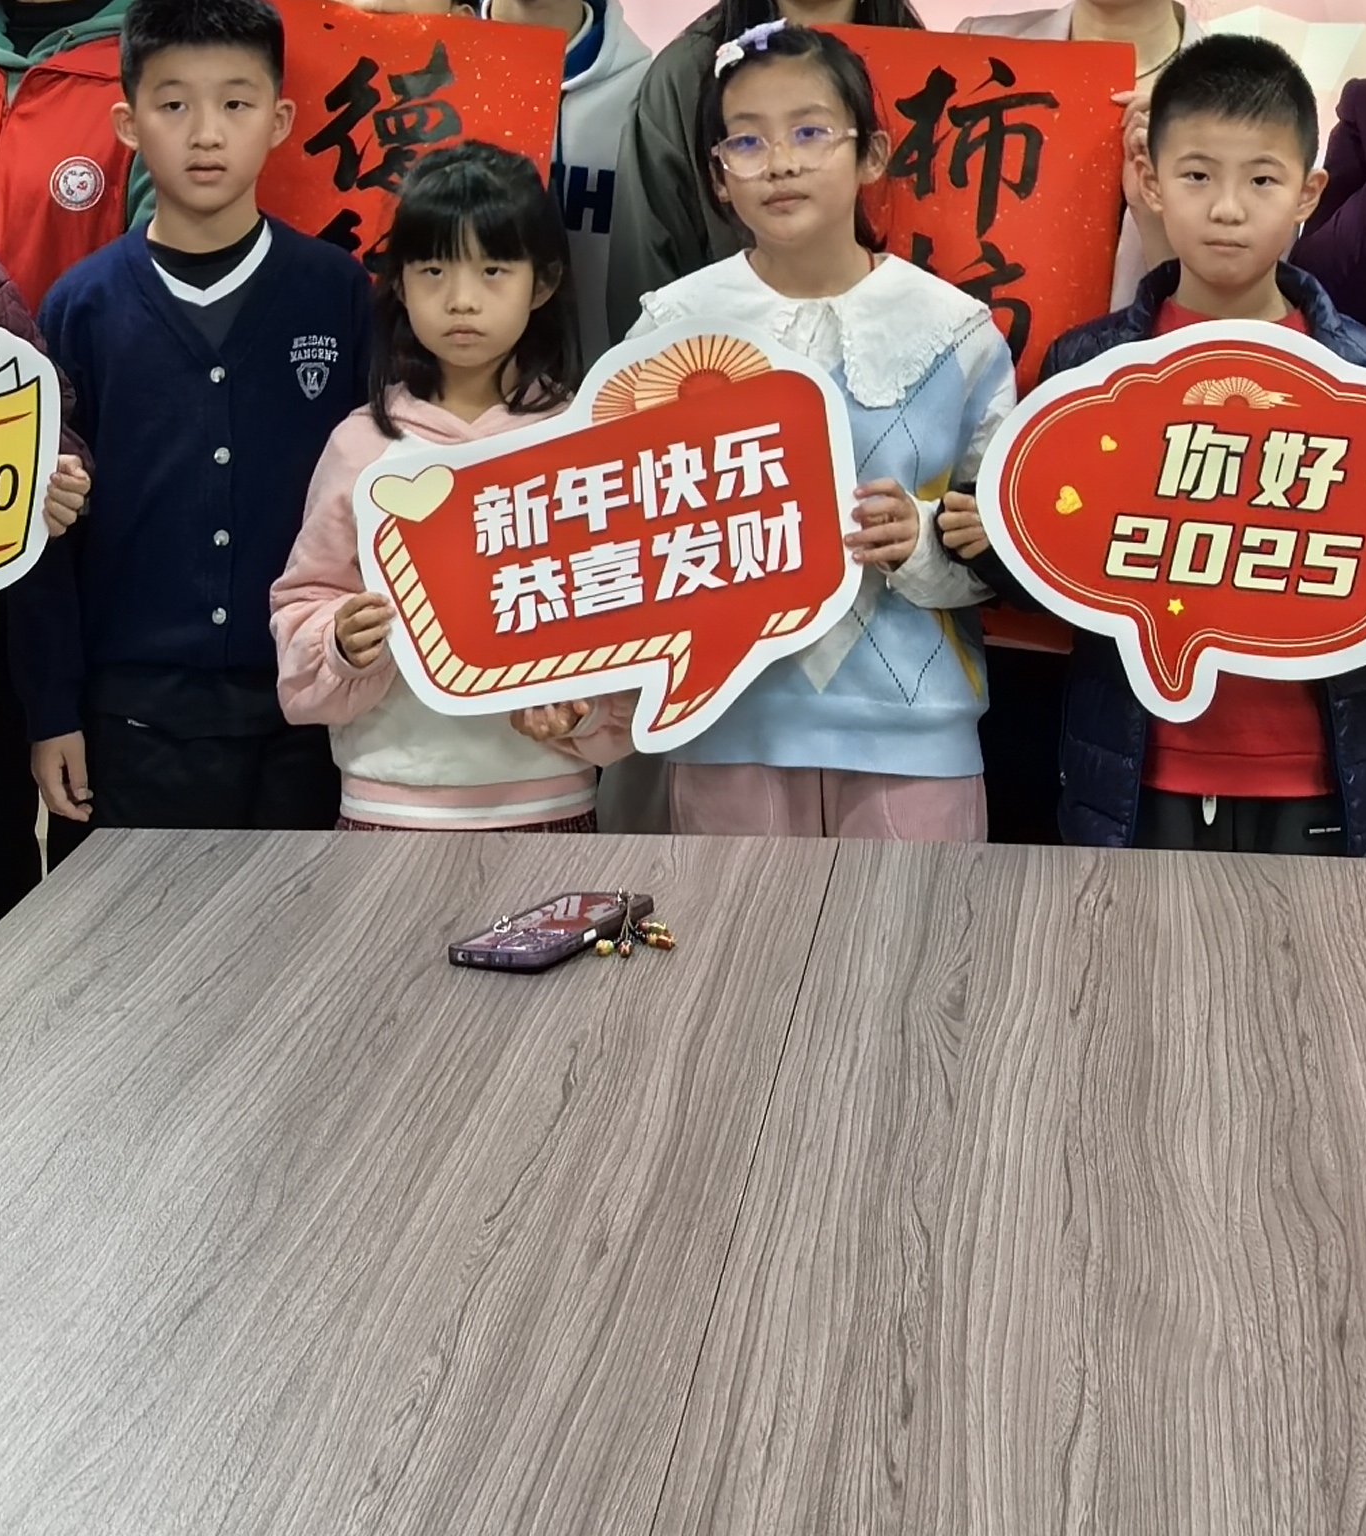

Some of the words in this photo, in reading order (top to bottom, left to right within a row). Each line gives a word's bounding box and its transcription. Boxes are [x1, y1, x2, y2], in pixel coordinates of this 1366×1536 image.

[473, 423, 789, 557] 新年快乐
[1156, 421, 1352, 512] 你好
[491, 502, 802, 635] 恭喜发财
[1104, 514, 1366, 598] 2025
